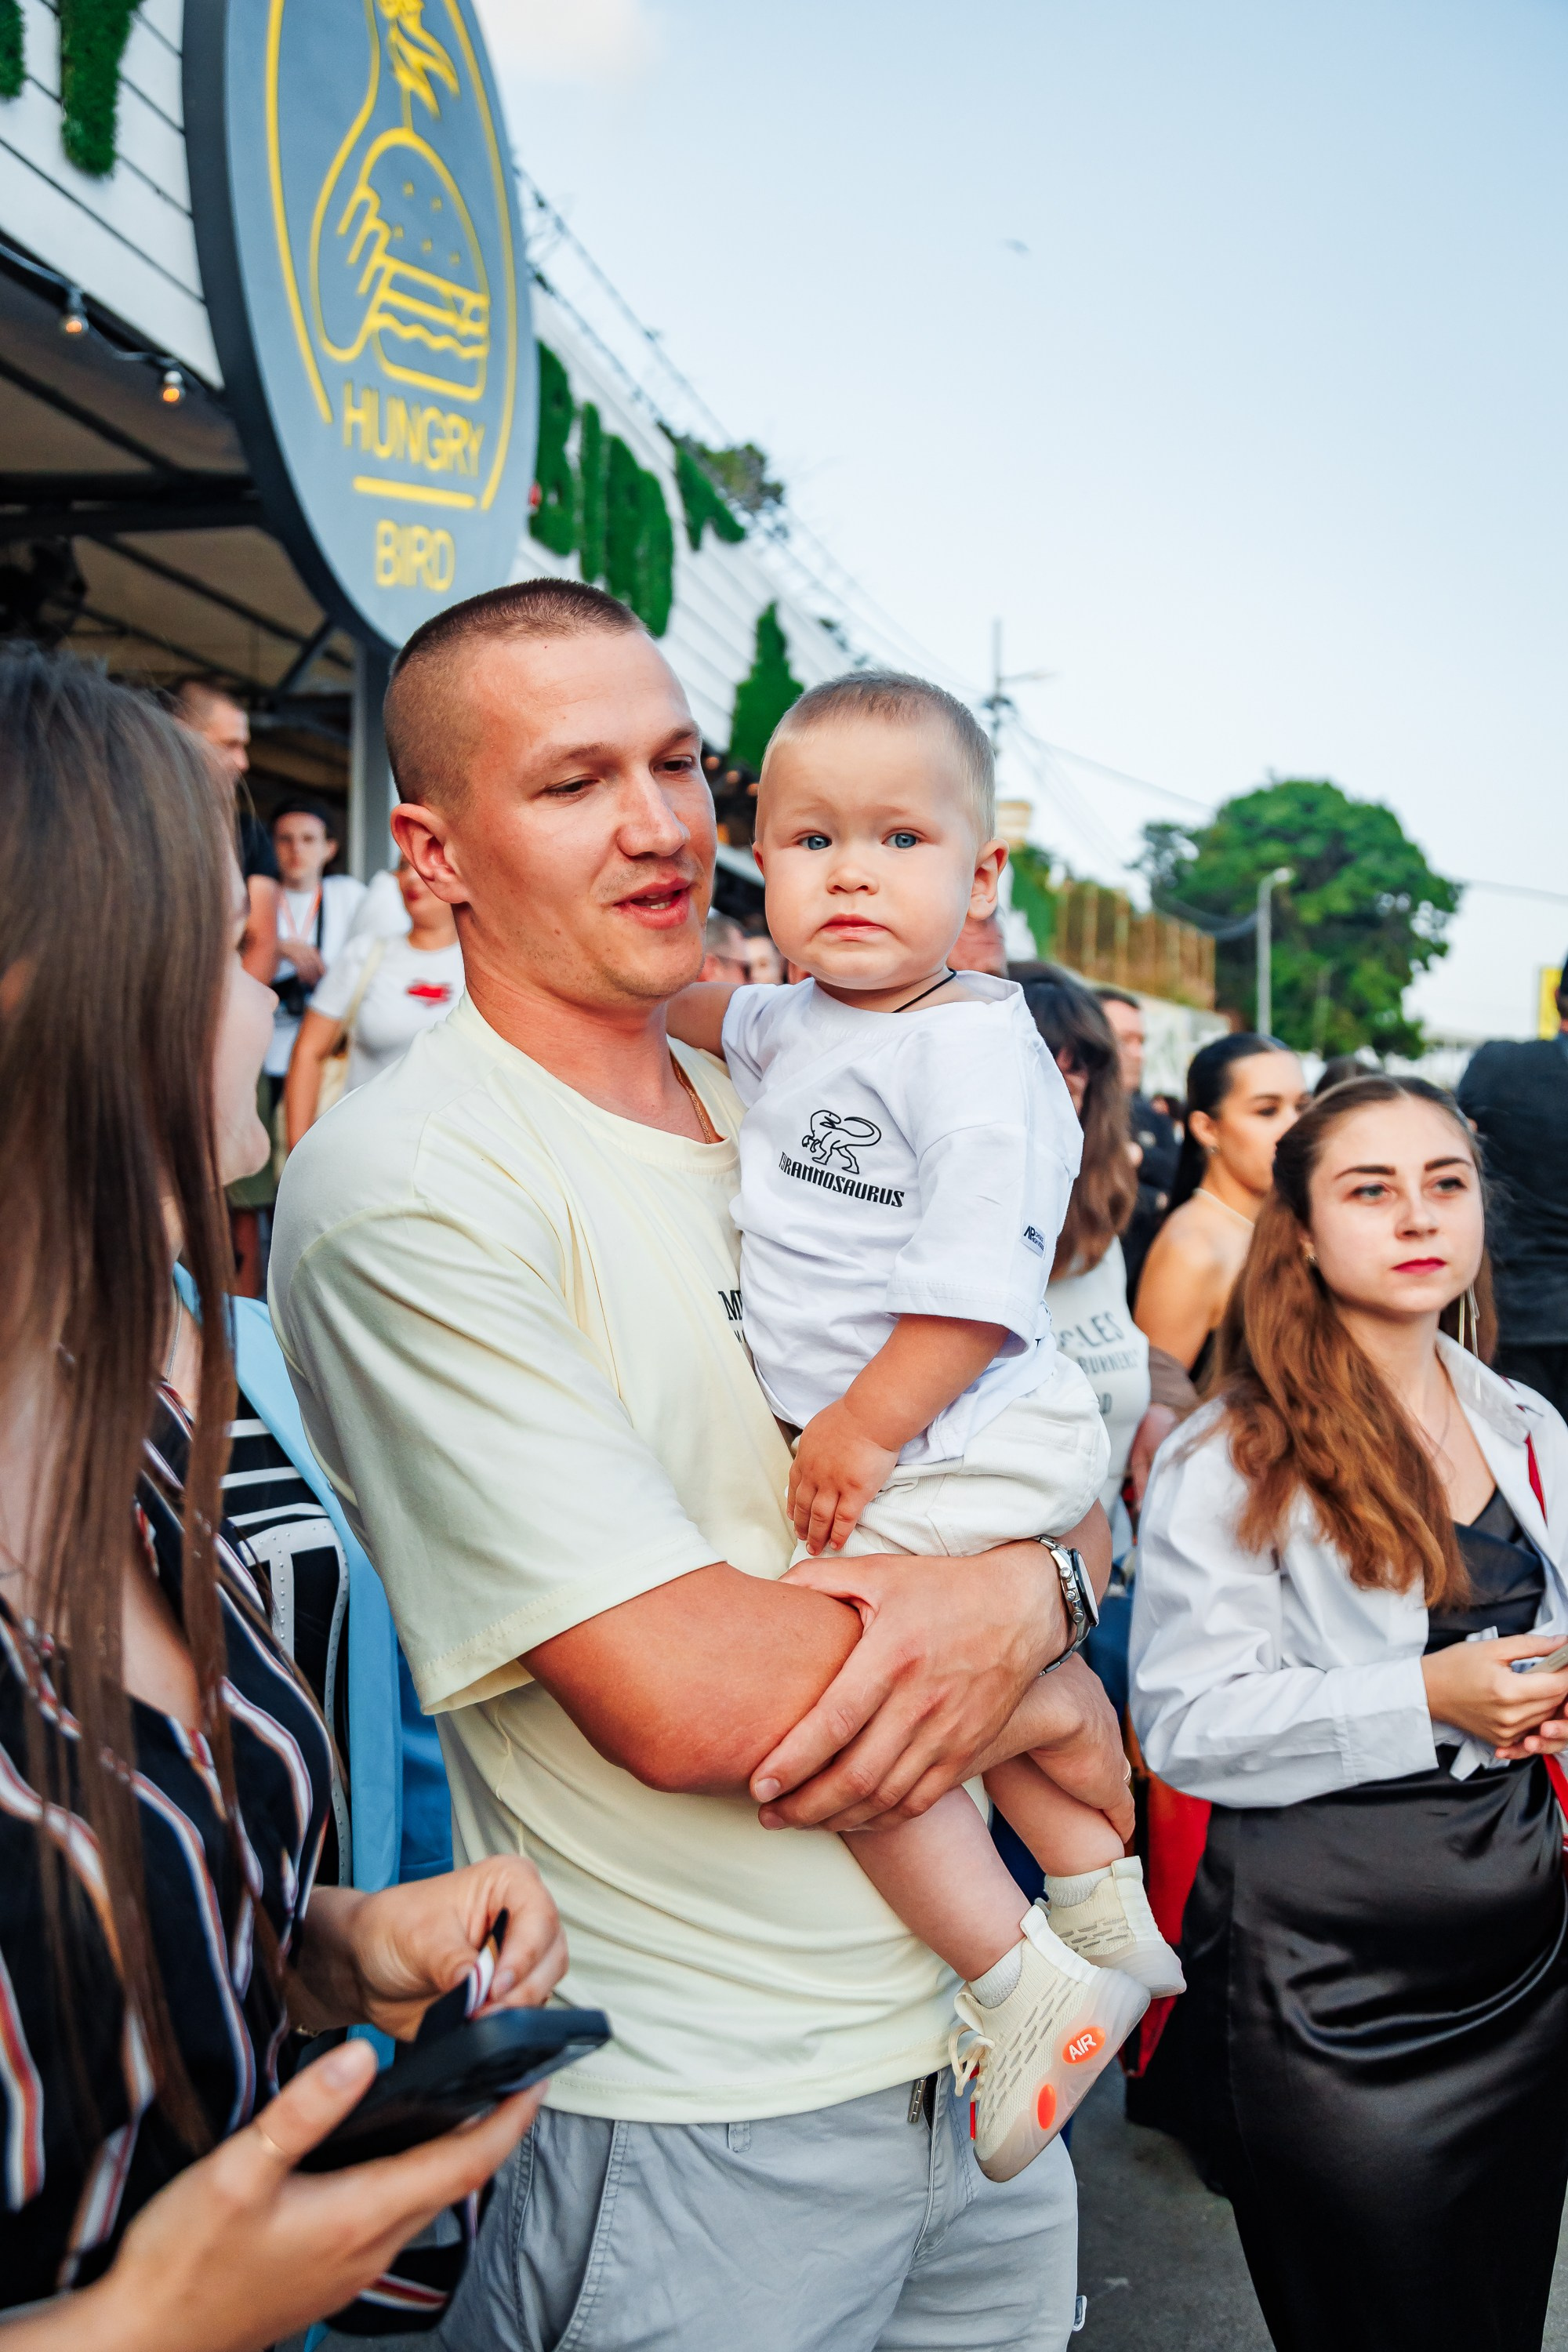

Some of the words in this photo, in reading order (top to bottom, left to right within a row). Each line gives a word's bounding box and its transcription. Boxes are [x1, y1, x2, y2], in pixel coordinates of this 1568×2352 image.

[343, 380, 485, 477] HUNGRY
[376, 518, 456, 593] BIRD
[779, 1151, 905, 1207] TYRANNOSAURUS
[1069, 2033, 1097, 2061] AIR
